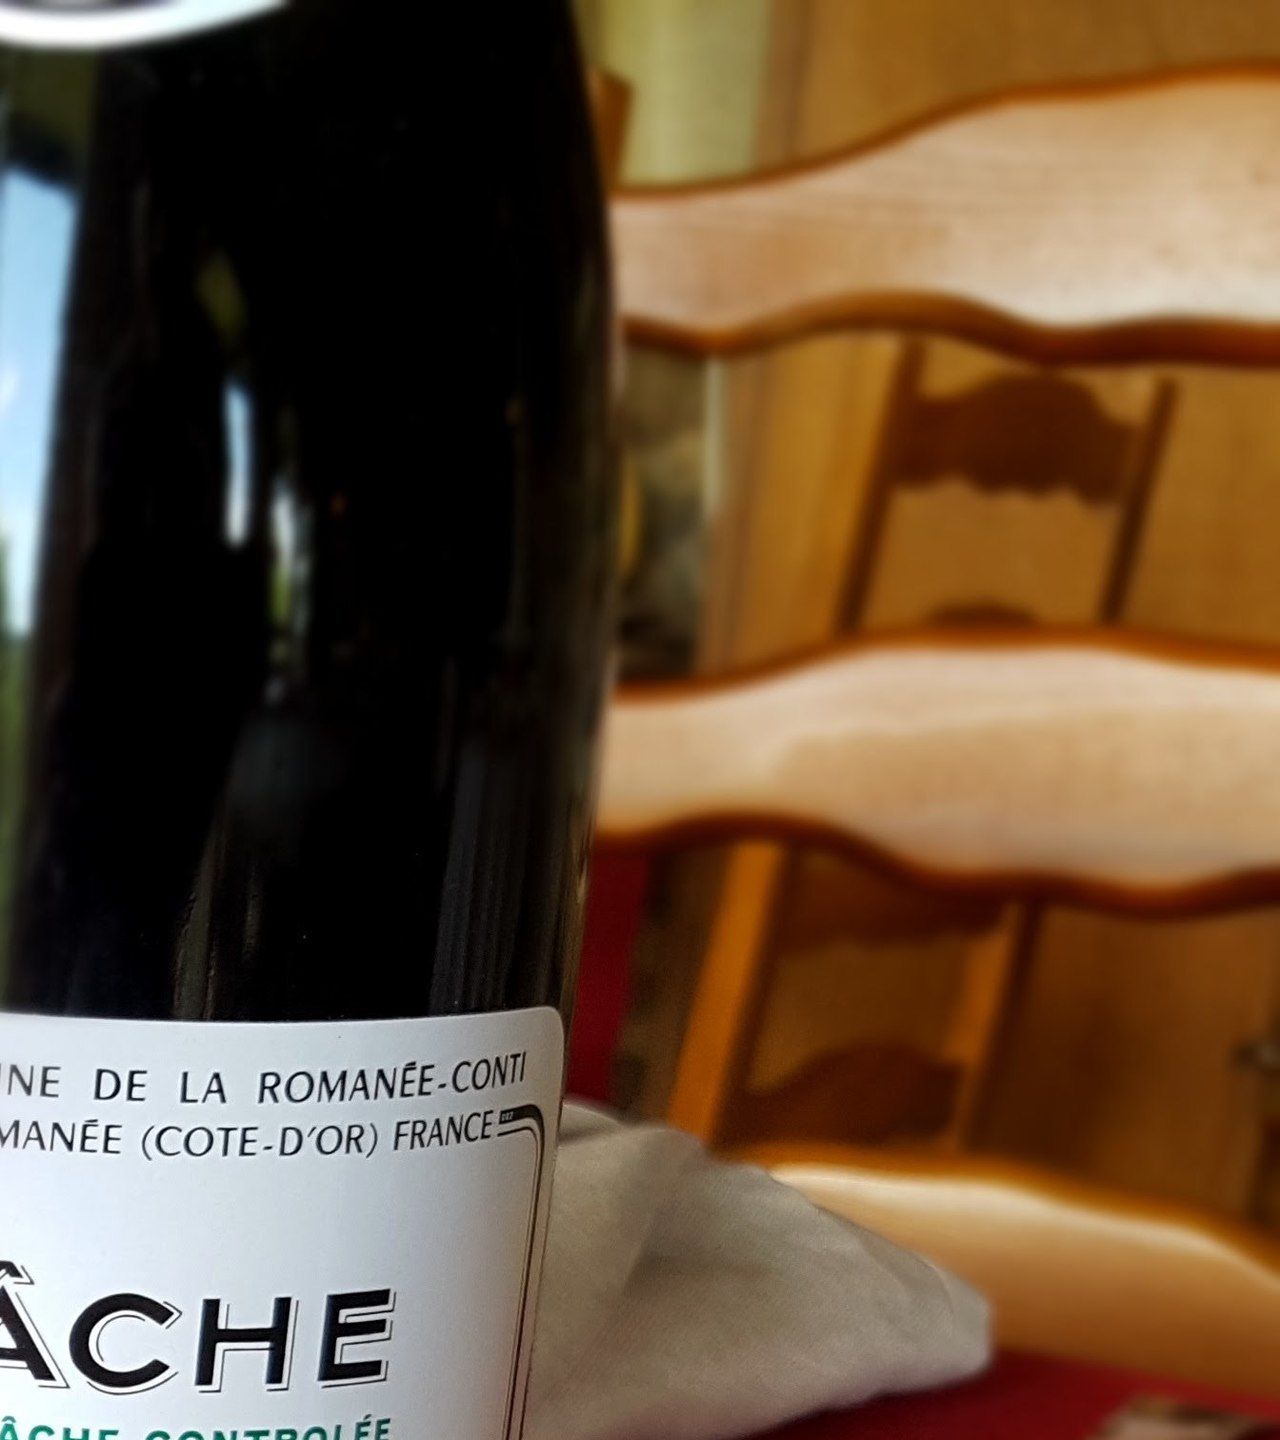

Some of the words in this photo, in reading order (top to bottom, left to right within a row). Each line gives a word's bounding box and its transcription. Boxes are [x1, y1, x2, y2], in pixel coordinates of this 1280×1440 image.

[93, 1068, 148, 1102] DE
[179, 1070, 226, 1104] LA
[257, 1051, 527, 1104] ROMANÉE-CONTI
[141, 1122, 379, 1161] (COTE-D'OR)
[393, 1109, 495, 1151] FRANCE
